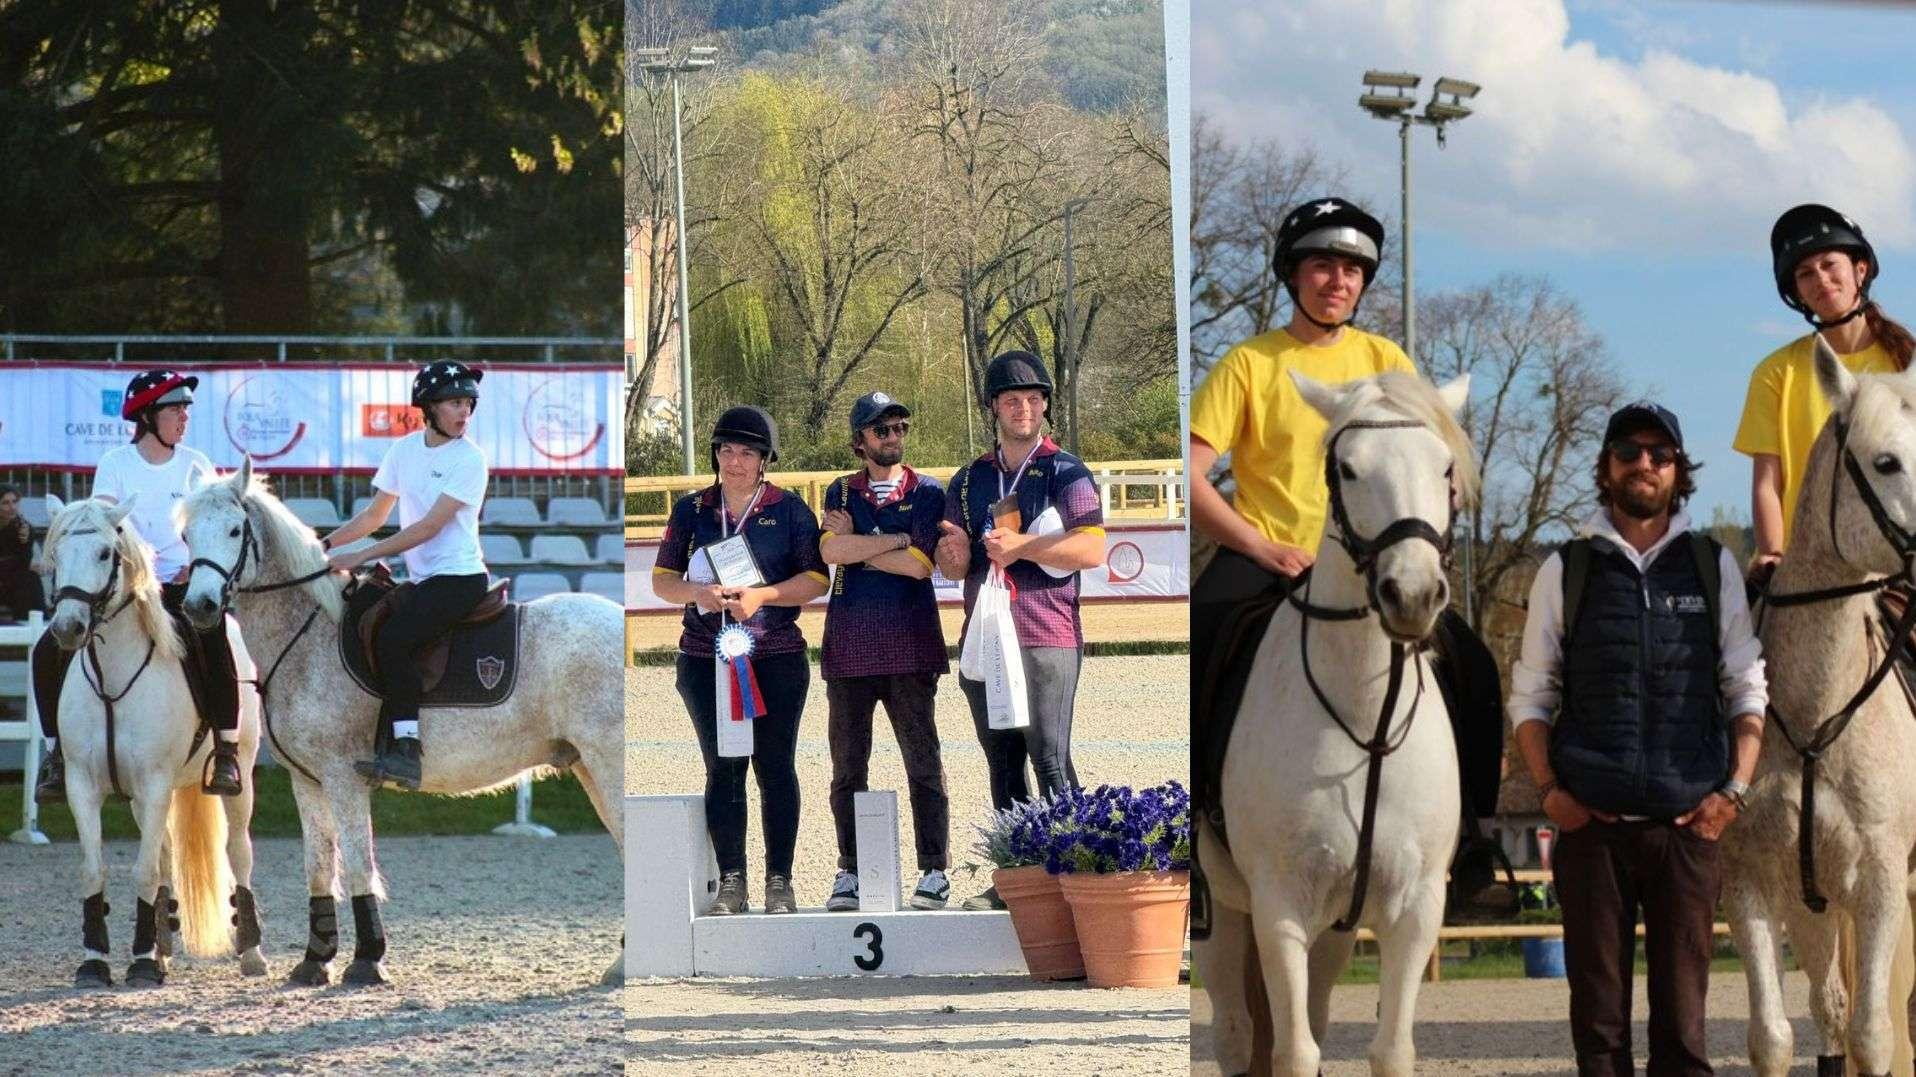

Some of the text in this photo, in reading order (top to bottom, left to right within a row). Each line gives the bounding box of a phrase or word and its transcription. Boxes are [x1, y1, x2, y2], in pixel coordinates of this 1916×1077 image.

[65, 423, 97, 436] CAVE
[98, 423, 114, 436] DE
[759, 517, 777, 526] Caro
[853, 922, 884, 971] 3
